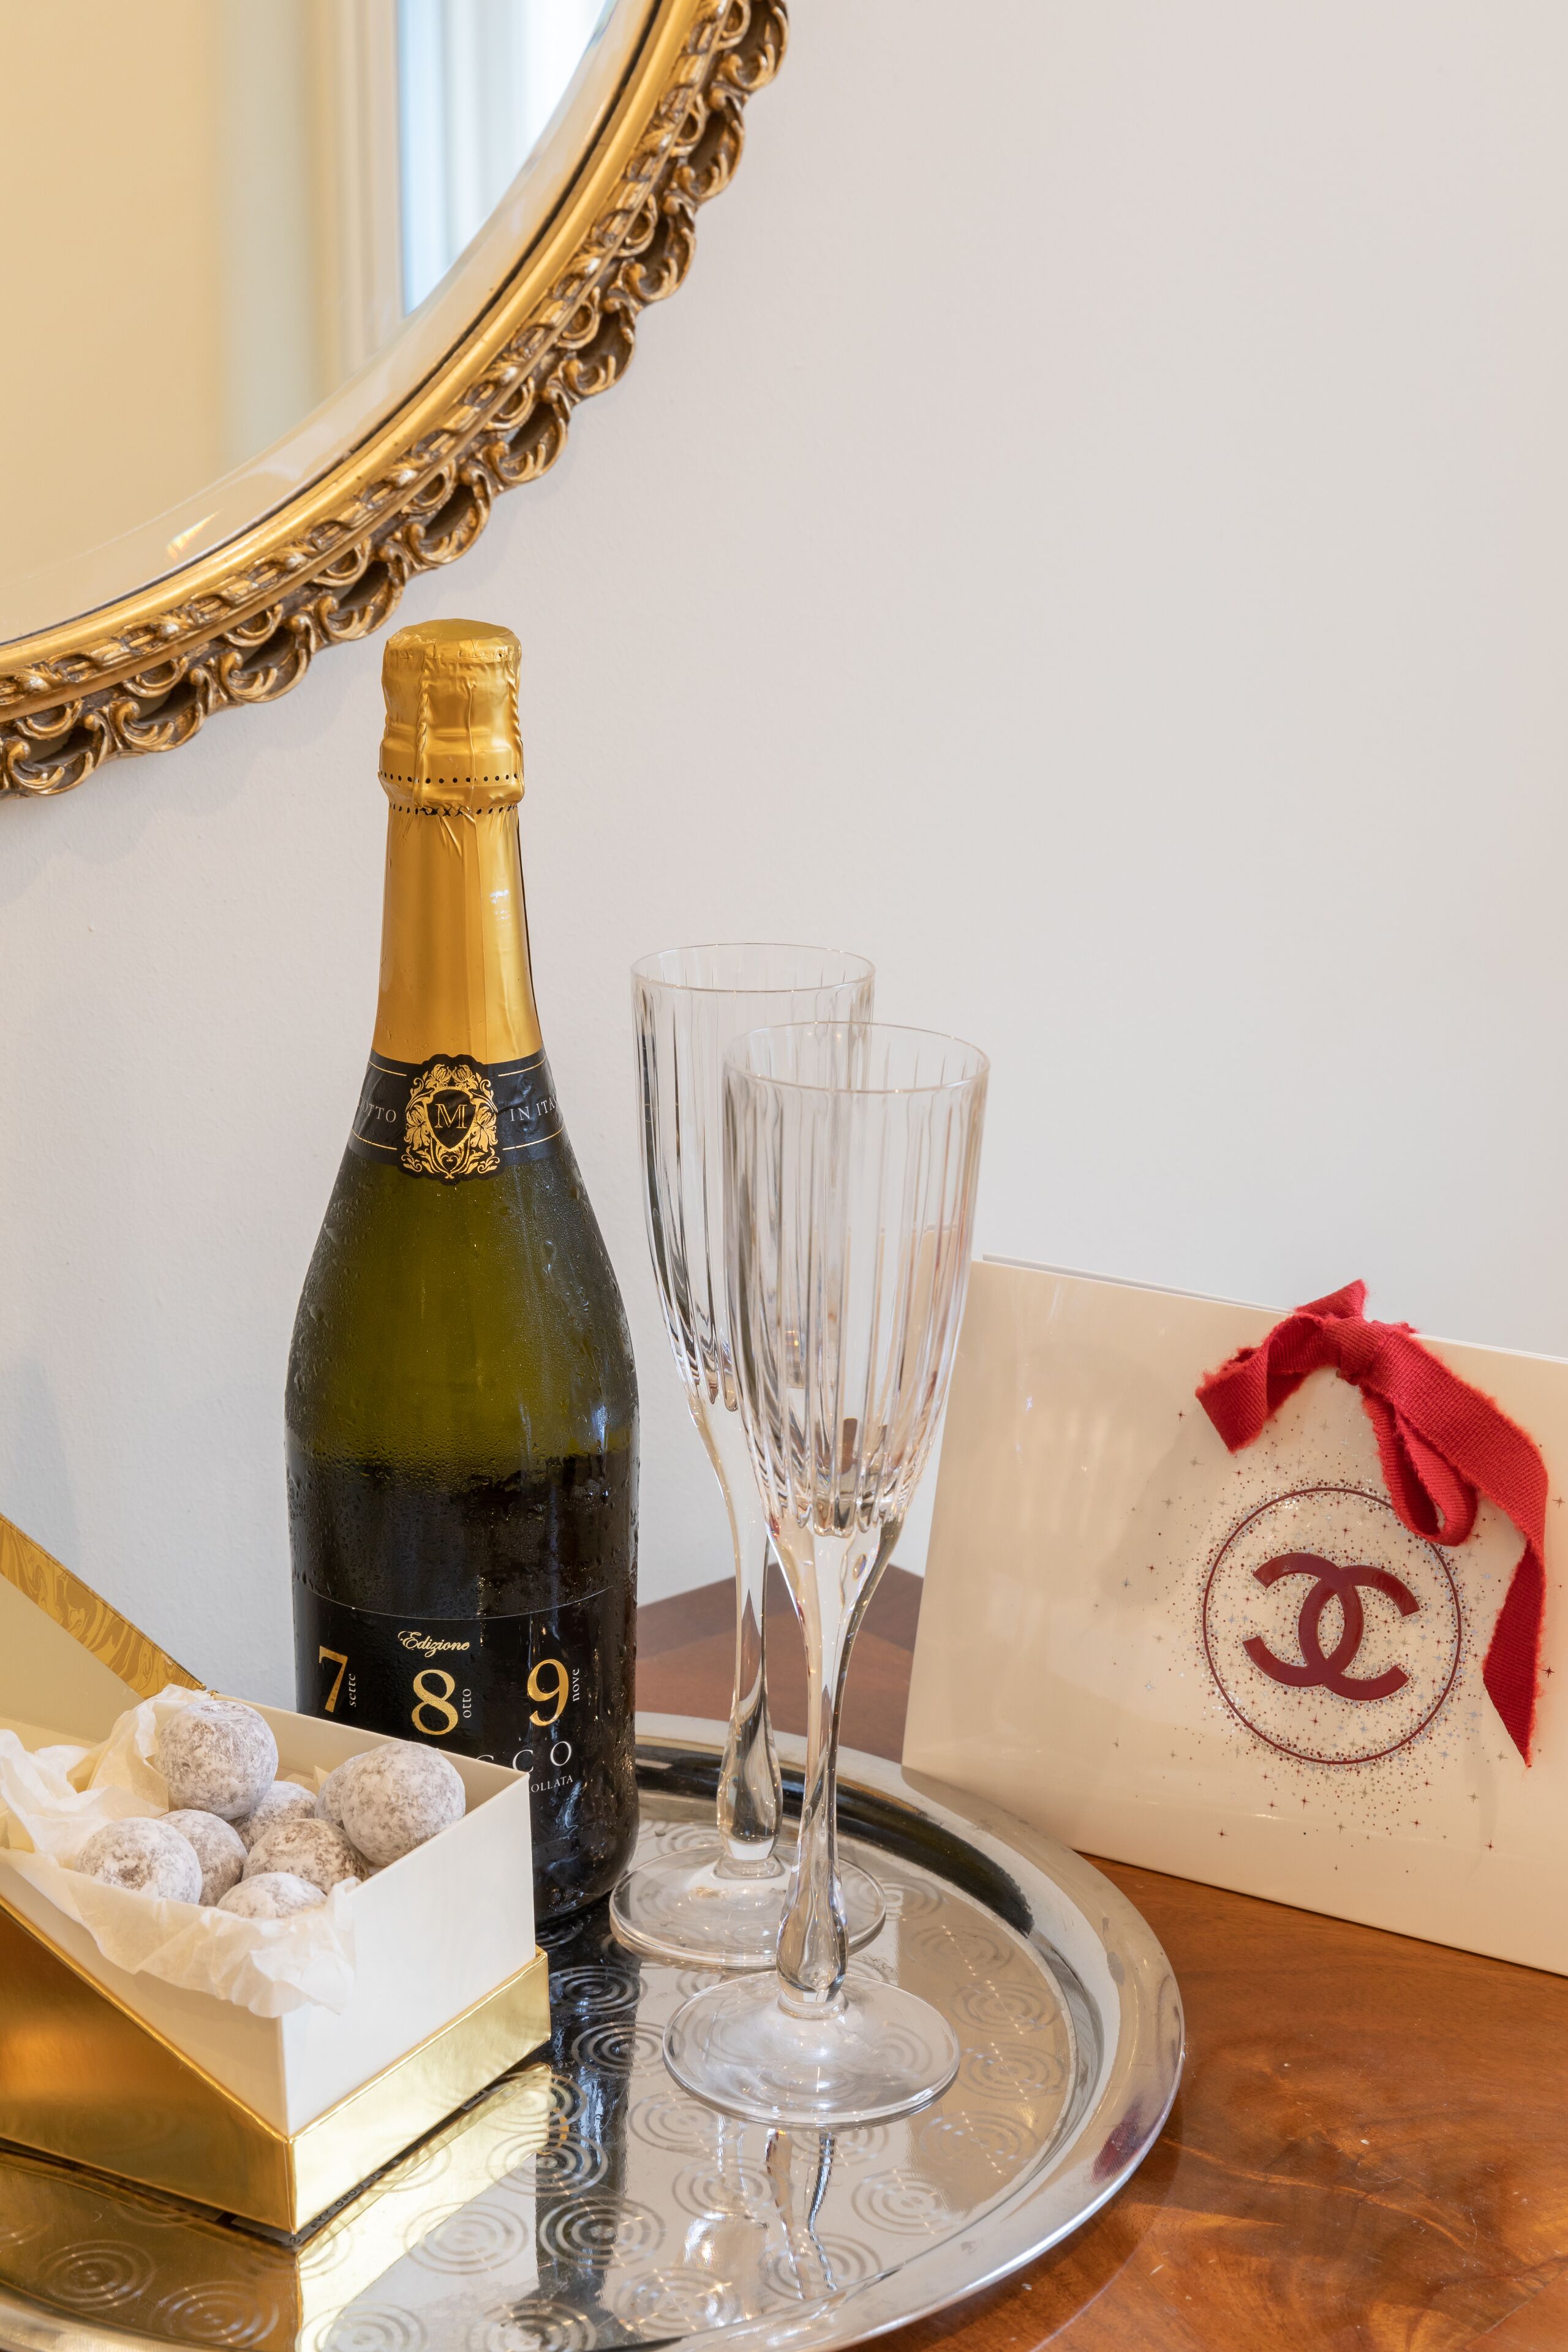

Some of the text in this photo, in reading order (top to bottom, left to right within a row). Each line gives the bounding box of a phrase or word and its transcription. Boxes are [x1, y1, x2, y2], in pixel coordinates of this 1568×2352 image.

[435, 1104, 467, 1129] M
[510, 1106, 530, 1121] IN
[398, 1630, 470, 1658] Edizione
[318, 1645, 569, 1735] 7 8 9
[348, 1673, 357, 1707] sette
[462, 1689, 472, 1718] otto
[476, 1741, 572, 1774] CO
[529, 1775, 573, 1793] OLLATA
